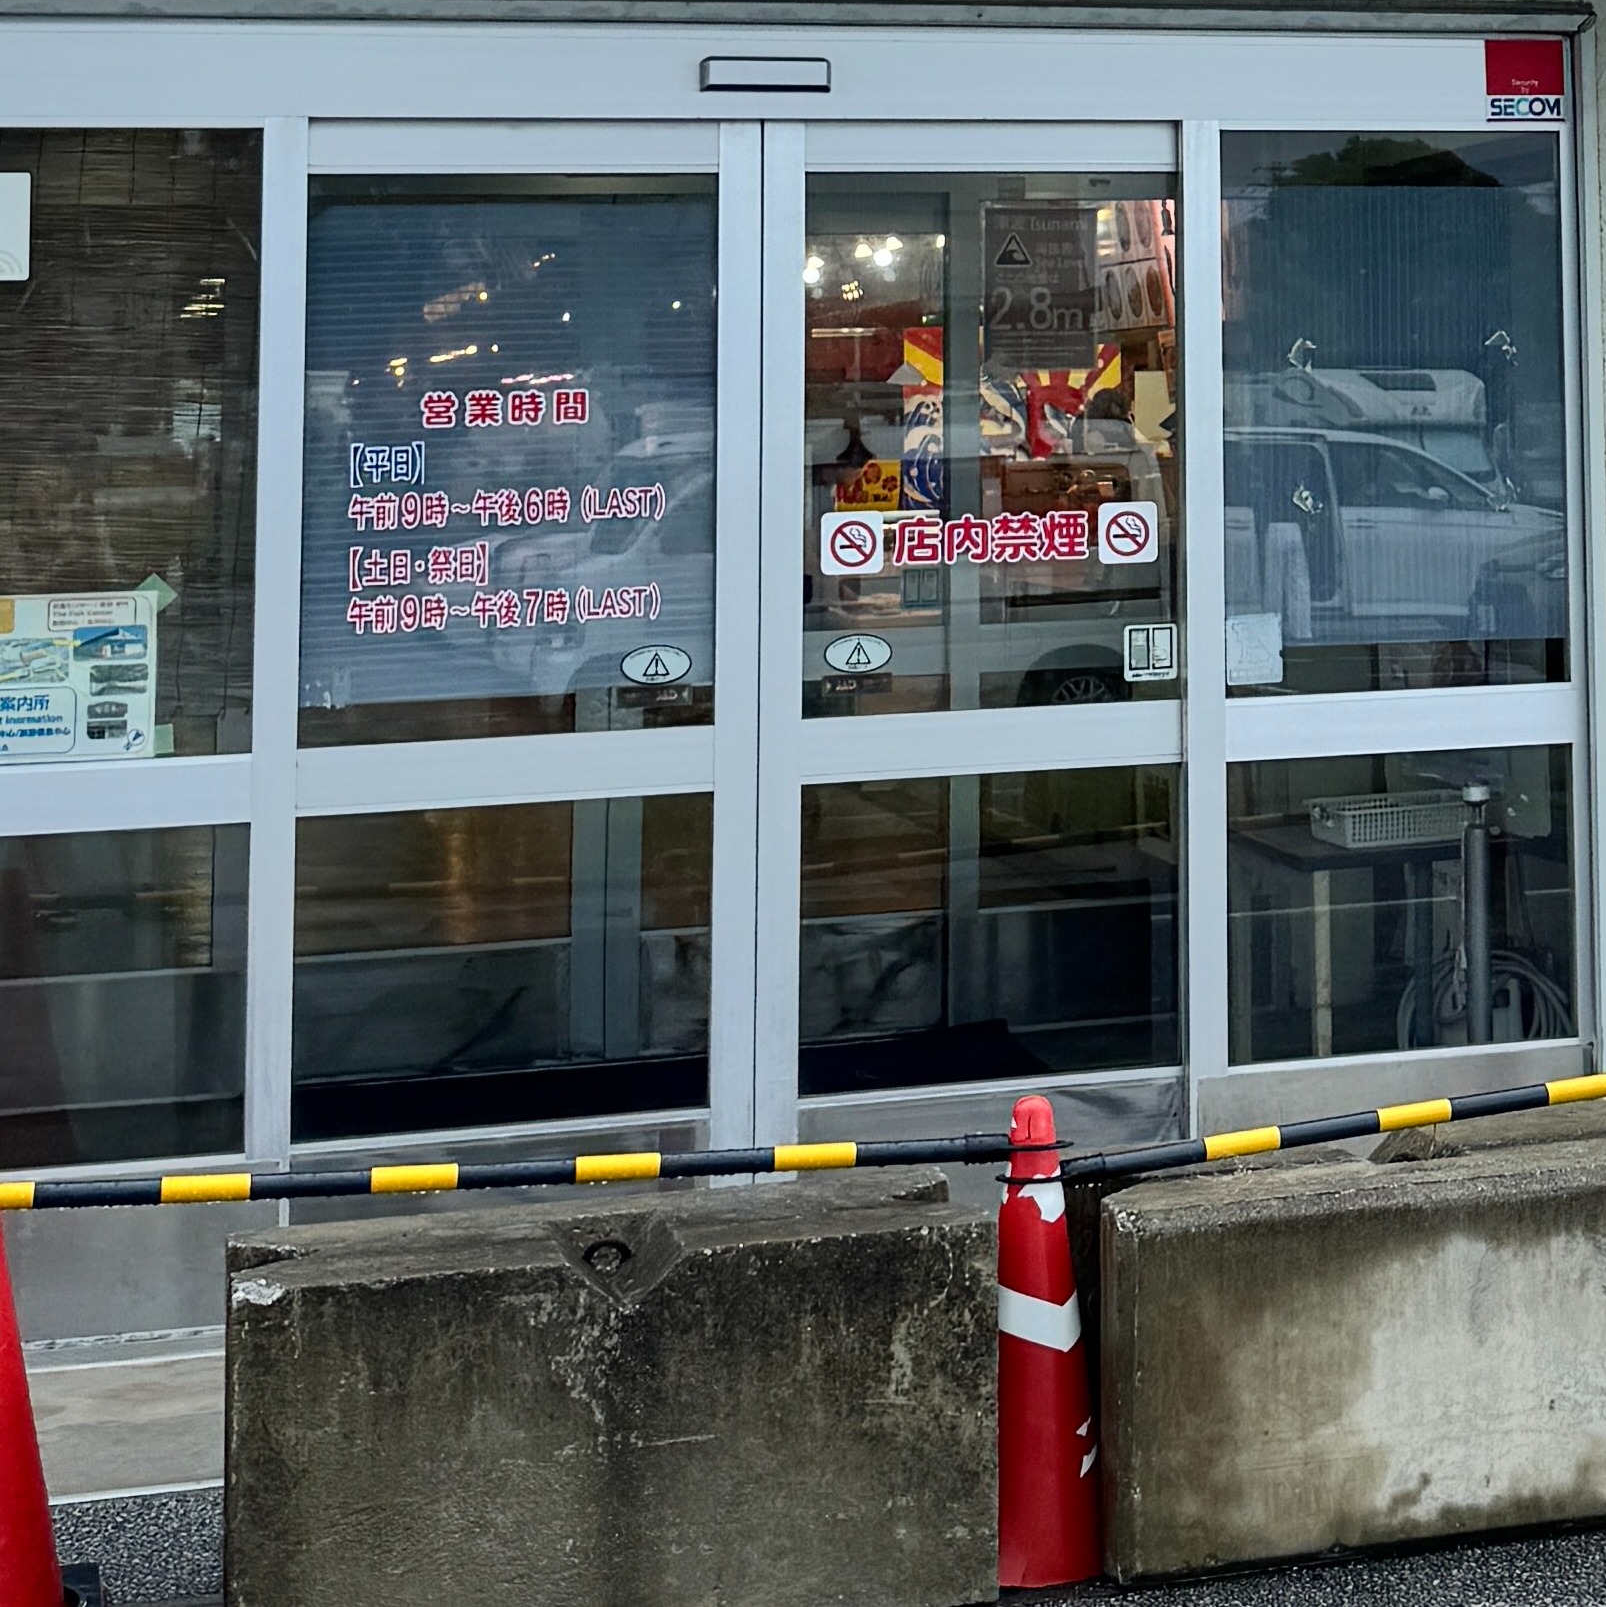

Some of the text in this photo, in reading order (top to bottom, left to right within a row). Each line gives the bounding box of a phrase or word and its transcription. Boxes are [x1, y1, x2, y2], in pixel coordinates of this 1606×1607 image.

[1490, 97, 1561, 117] SECOM
[990, 286, 1084, 330] 2.8m
[421, 389, 589, 428] 営業時間
[349, 441, 425, 488] 【平日】
[891, 509, 1089, 566] 店内禁煙
